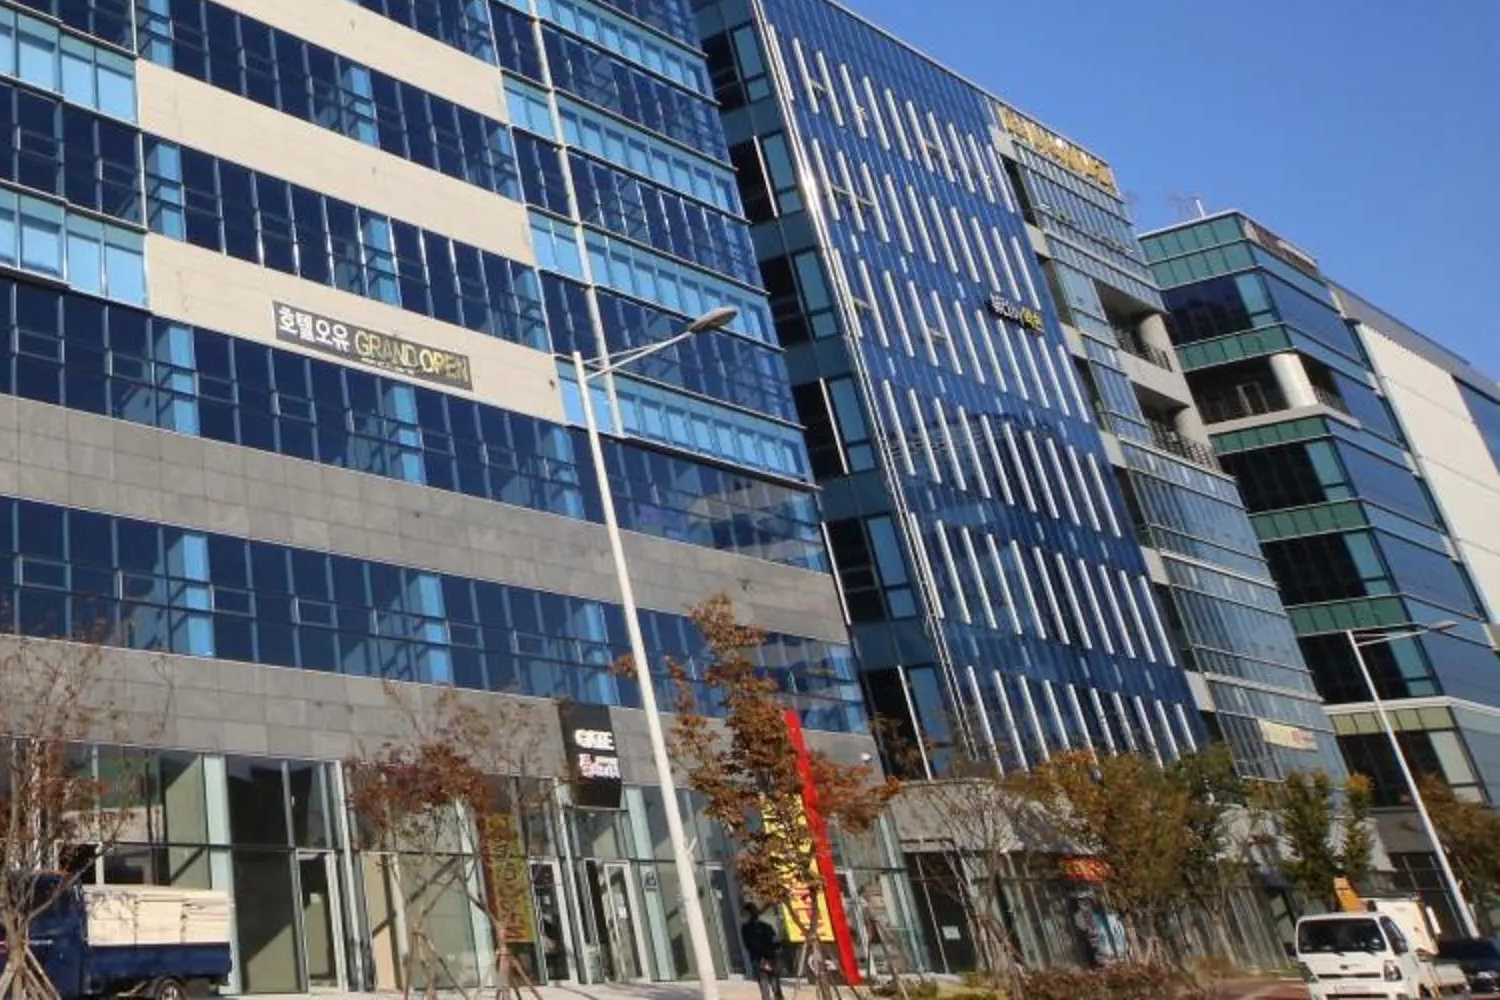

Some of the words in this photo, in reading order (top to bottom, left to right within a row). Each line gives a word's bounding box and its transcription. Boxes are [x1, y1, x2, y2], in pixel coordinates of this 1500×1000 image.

[277, 304, 351, 354] 호텔오유
[354, 330, 419, 369] GRAND
[419, 349, 470, 384] OPEN
